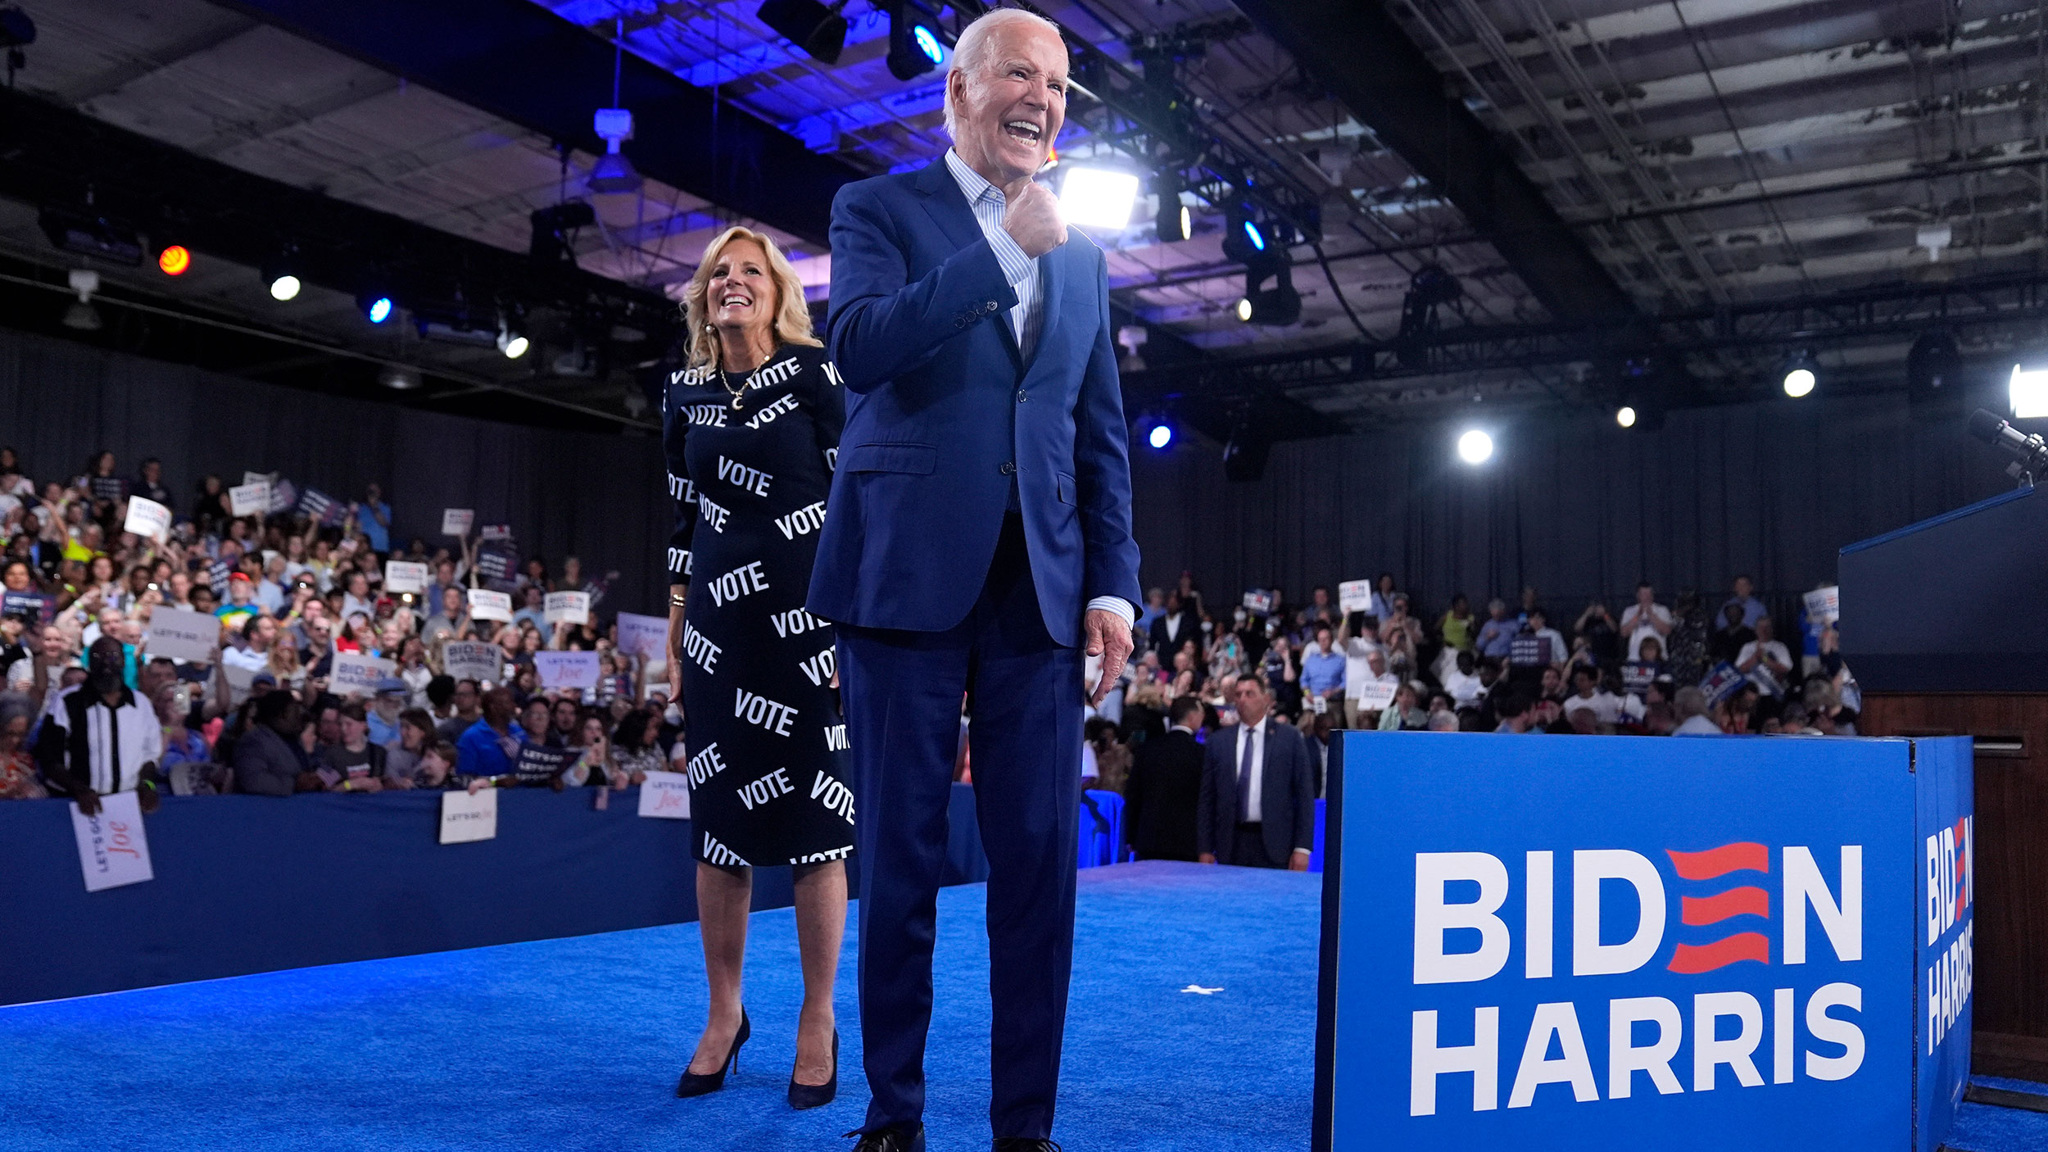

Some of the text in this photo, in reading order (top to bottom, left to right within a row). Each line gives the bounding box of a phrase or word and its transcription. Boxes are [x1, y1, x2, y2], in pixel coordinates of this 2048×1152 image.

[746, 356, 803, 390] VOTE
[680, 404, 728, 428] VOTE
[745, 393, 799, 430] VOTE
[667, 469, 697, 503] OTE
[717, 454, 773, 498] VOTE
[698, 491, 731, 534] VOTE
[774, 500, 828, 541] VOTE
[667, 547, 693, 576] OTE
[708, 560, 770, 608] VOTE
[448, 644, 497, 657] BIDEN
[682, 619, 723, 675] VOTE
[338, 662, 388, 678] BIDEN
[734, 687, 799, 738] VOTE
[824, 724, 851, 751] VOT
[686, 742, 727, 791] VOTE
[736, 767, 795, 811] VOTE
[810, 770, 856, 826] VOTE
[106, 820, 141, 859] Joe
[703, 830, 752, 867] VOT
[1926, 814, 1973, 947] BIDEN
[1413, 841, 1863, 985] BIDEN
[1928, 918, 1973, 1057] HARRIS
[1410, 981, 1867, 1117] HARRIS
